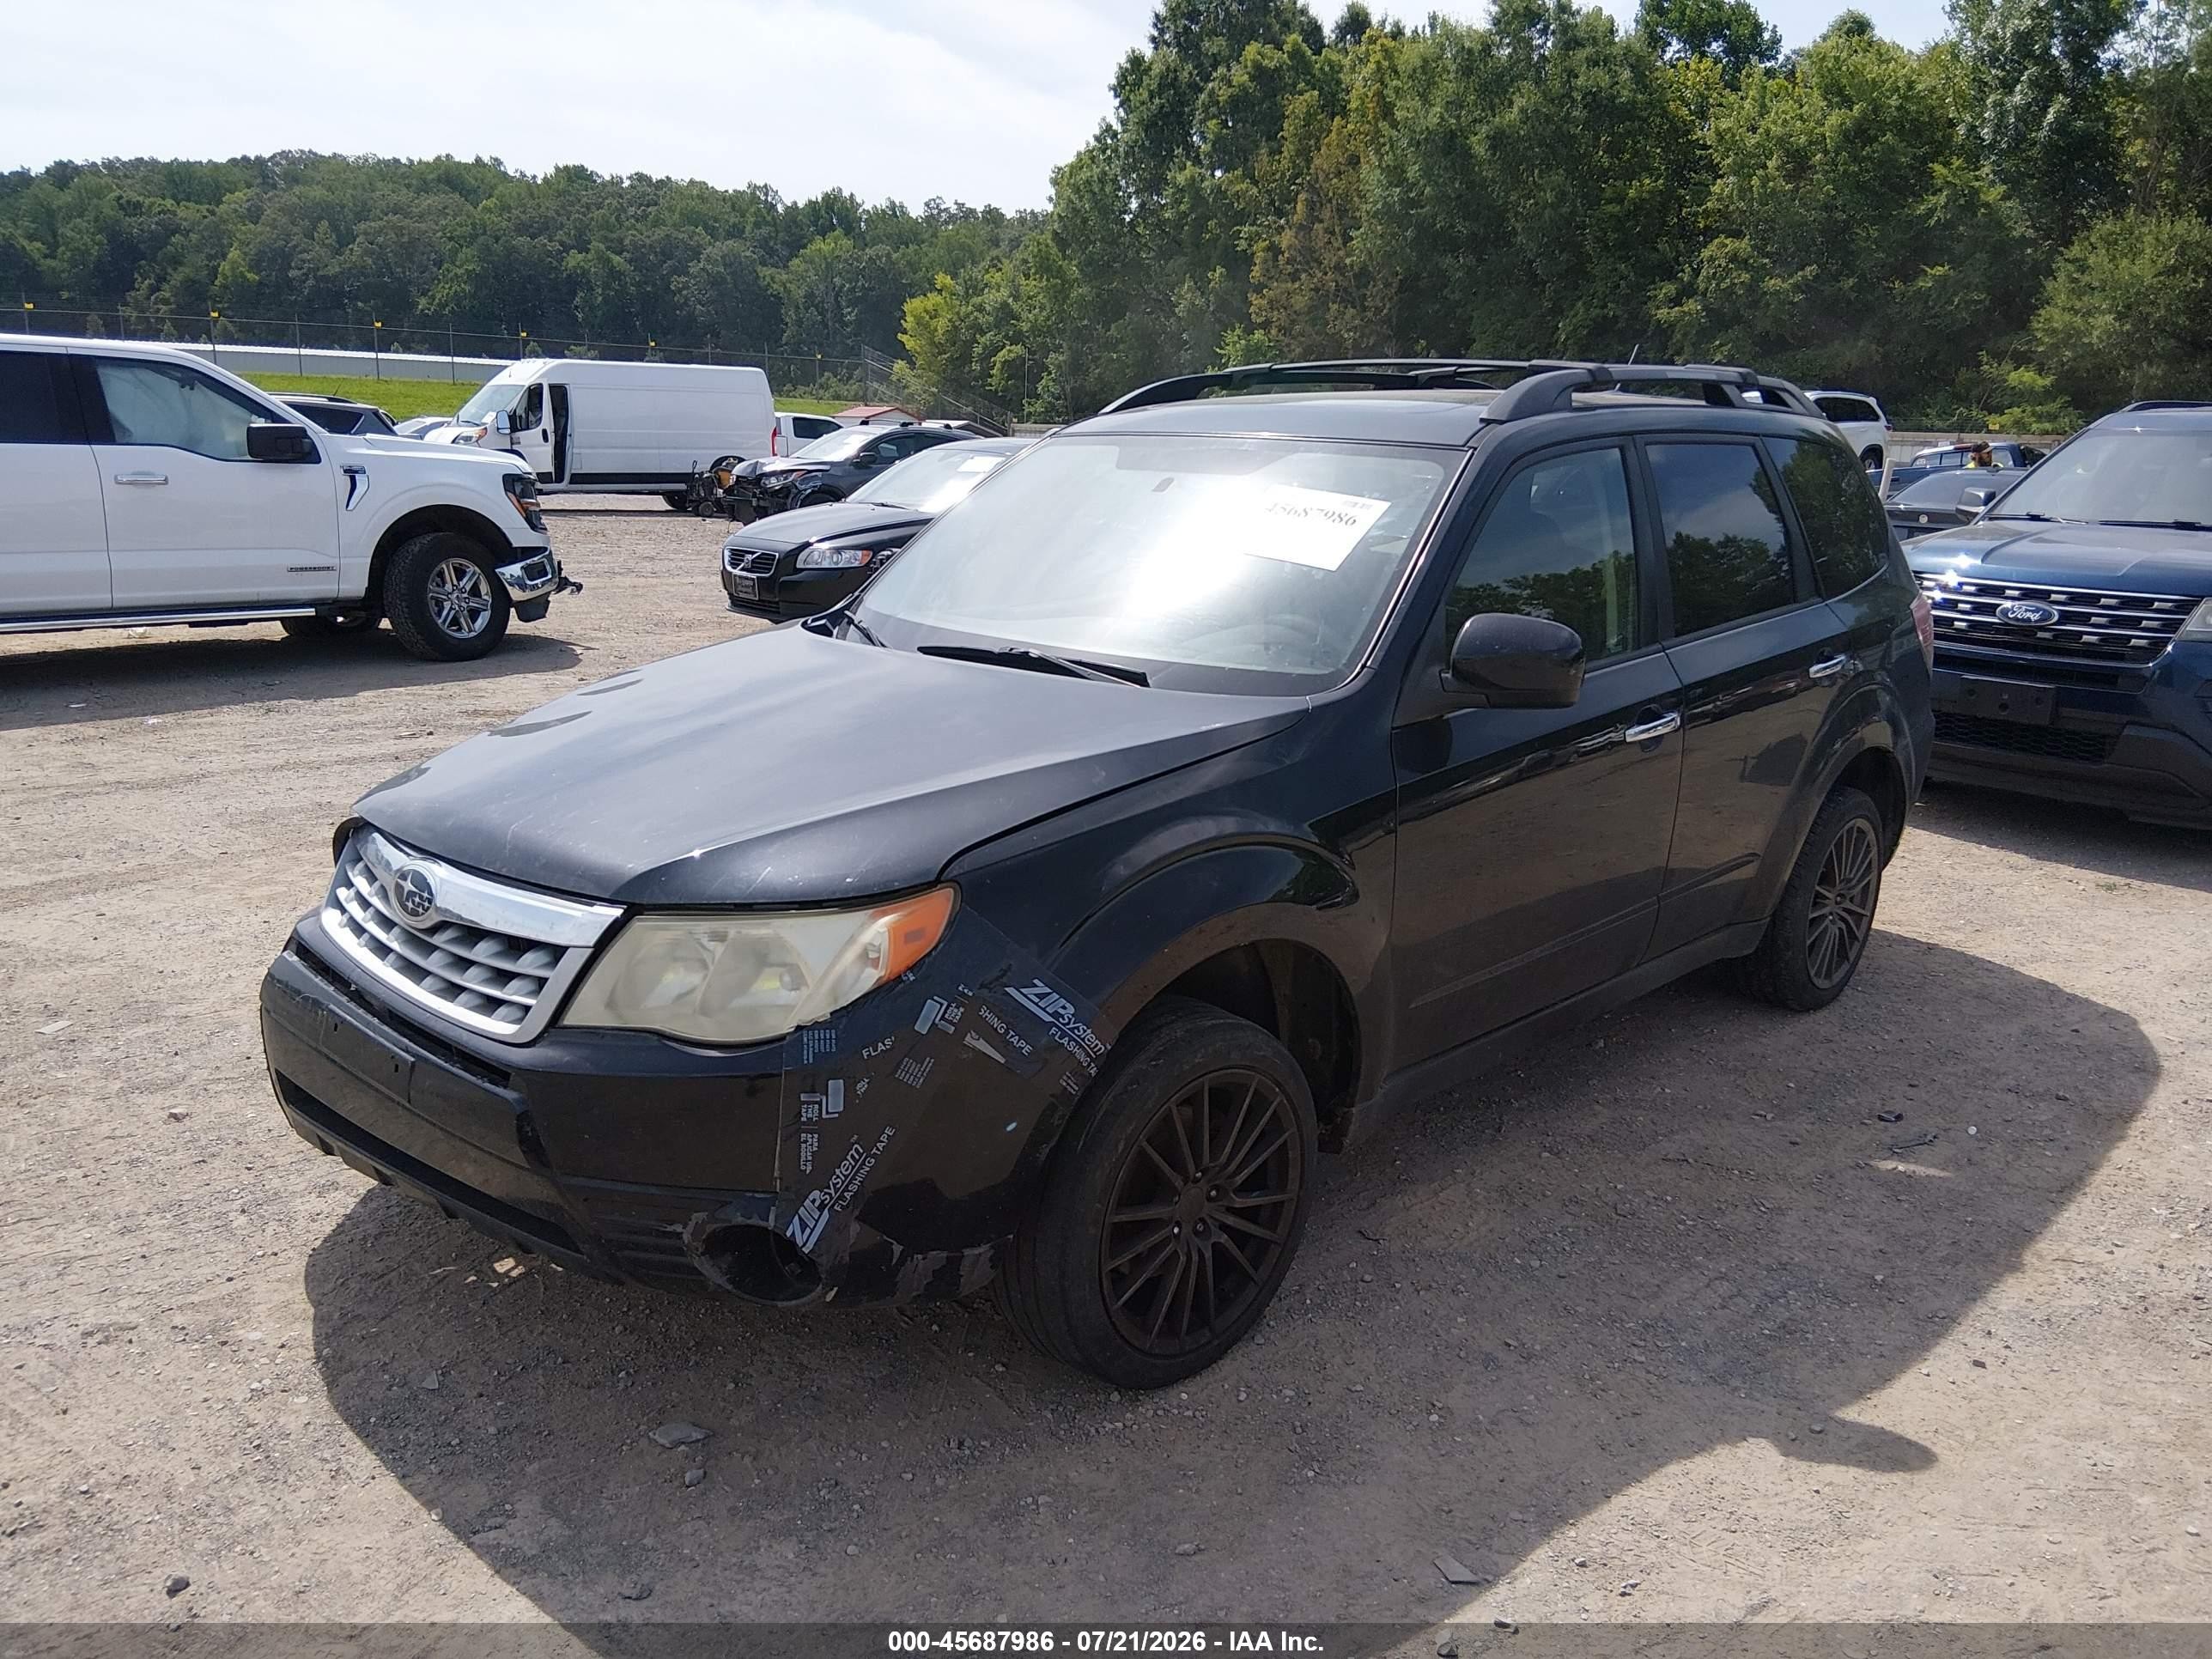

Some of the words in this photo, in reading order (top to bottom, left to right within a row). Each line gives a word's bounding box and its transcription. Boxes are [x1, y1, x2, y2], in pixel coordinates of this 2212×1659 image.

[2008, 605, 2044, 622] Ford
[862, 1036, 895, 1060] FLAS
[1005, 1030, 1033, 1057] TAPE
[1048, 1027, 1091, 1067] FLASHING
[834, 1157, 875, 1212] FLASHING
[871, 1126, 896, 1156] TAPE
